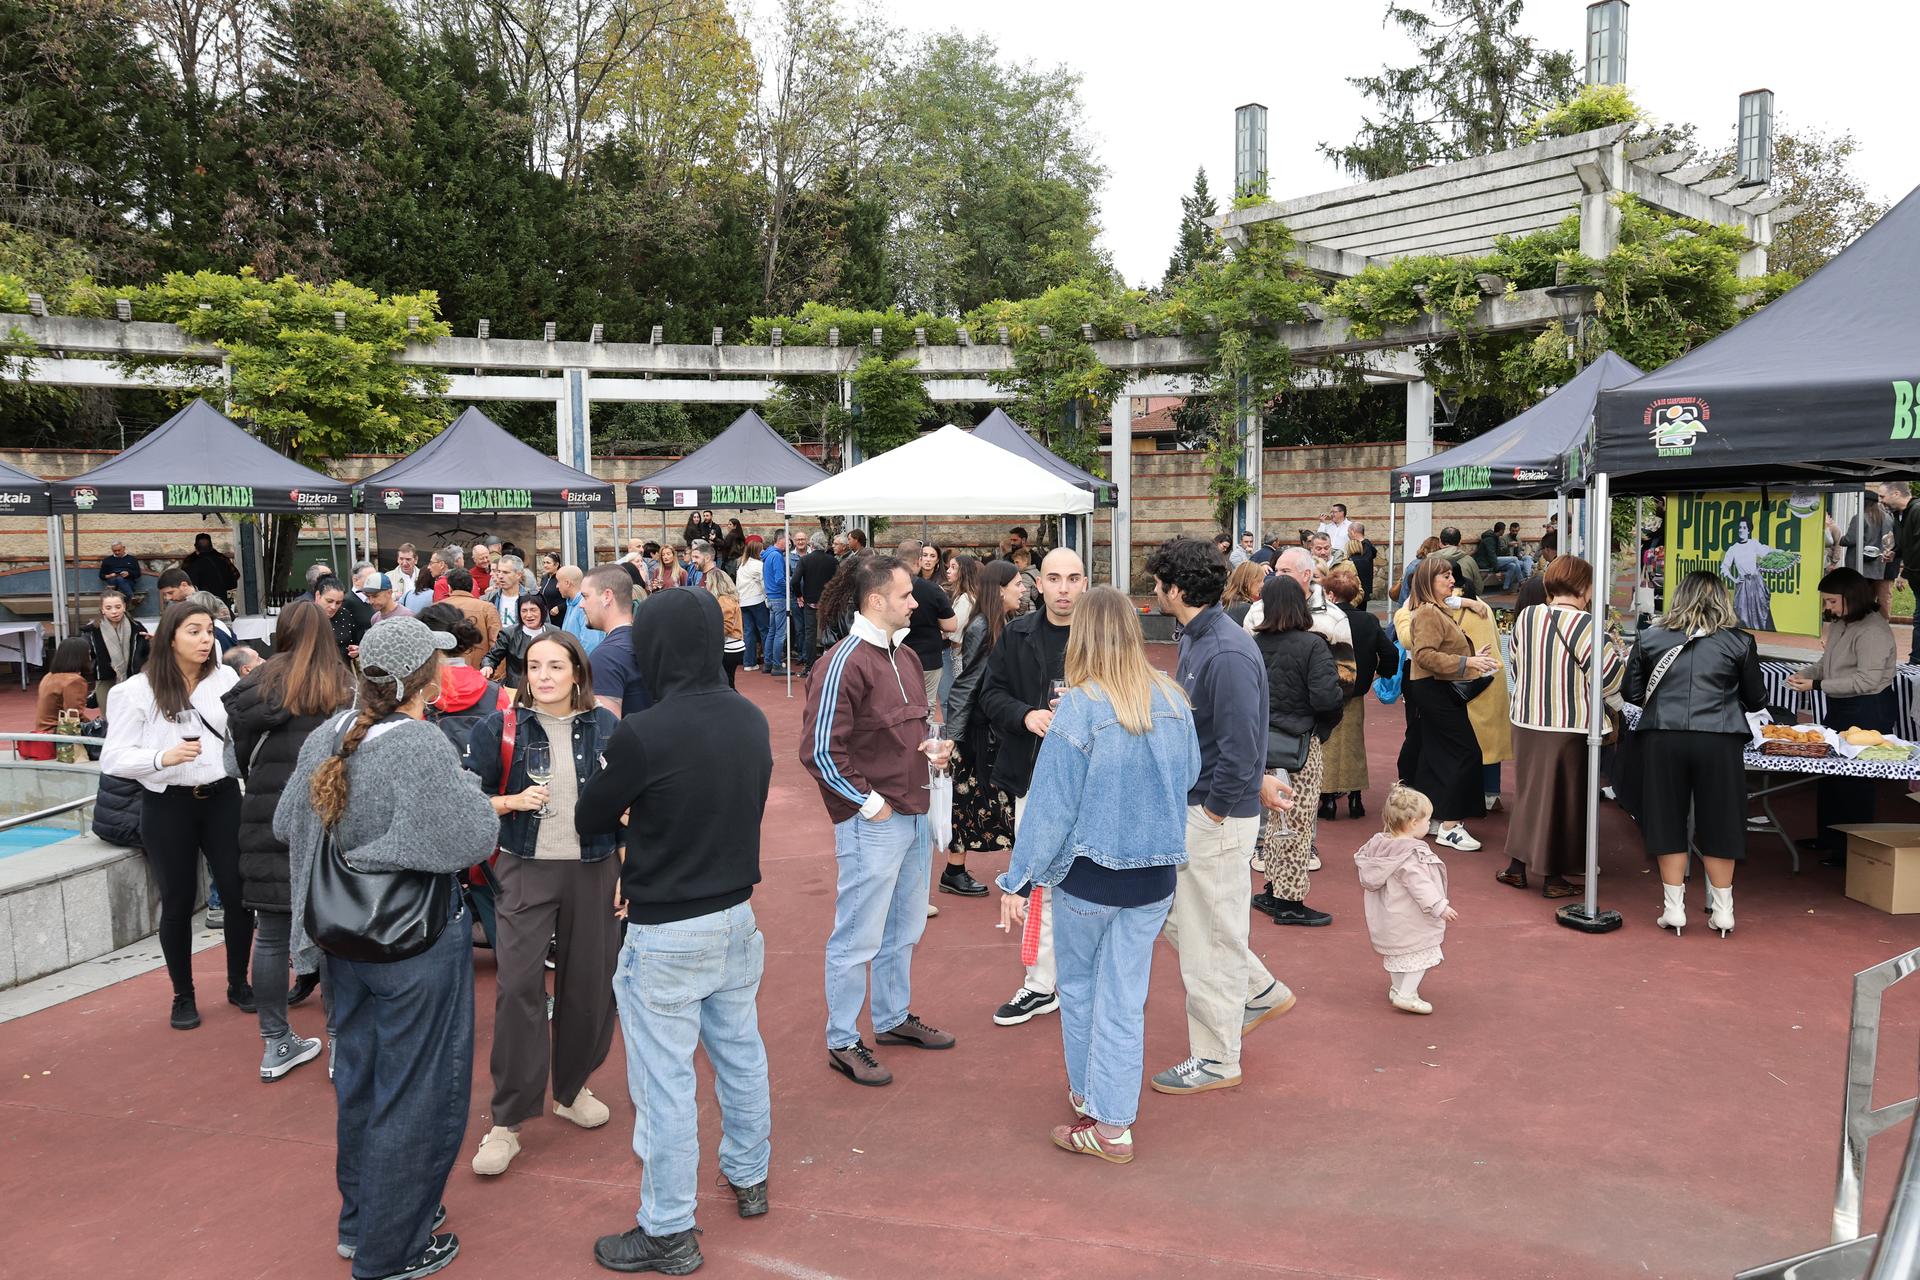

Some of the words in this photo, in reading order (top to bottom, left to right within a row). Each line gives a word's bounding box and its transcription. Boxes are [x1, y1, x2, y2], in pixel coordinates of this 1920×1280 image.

[1517, 469, 1549, 481] Bizkaia
[298, 493, 338, 504] Bizkaia
[567, 492, 601, 502] Bizkaia
